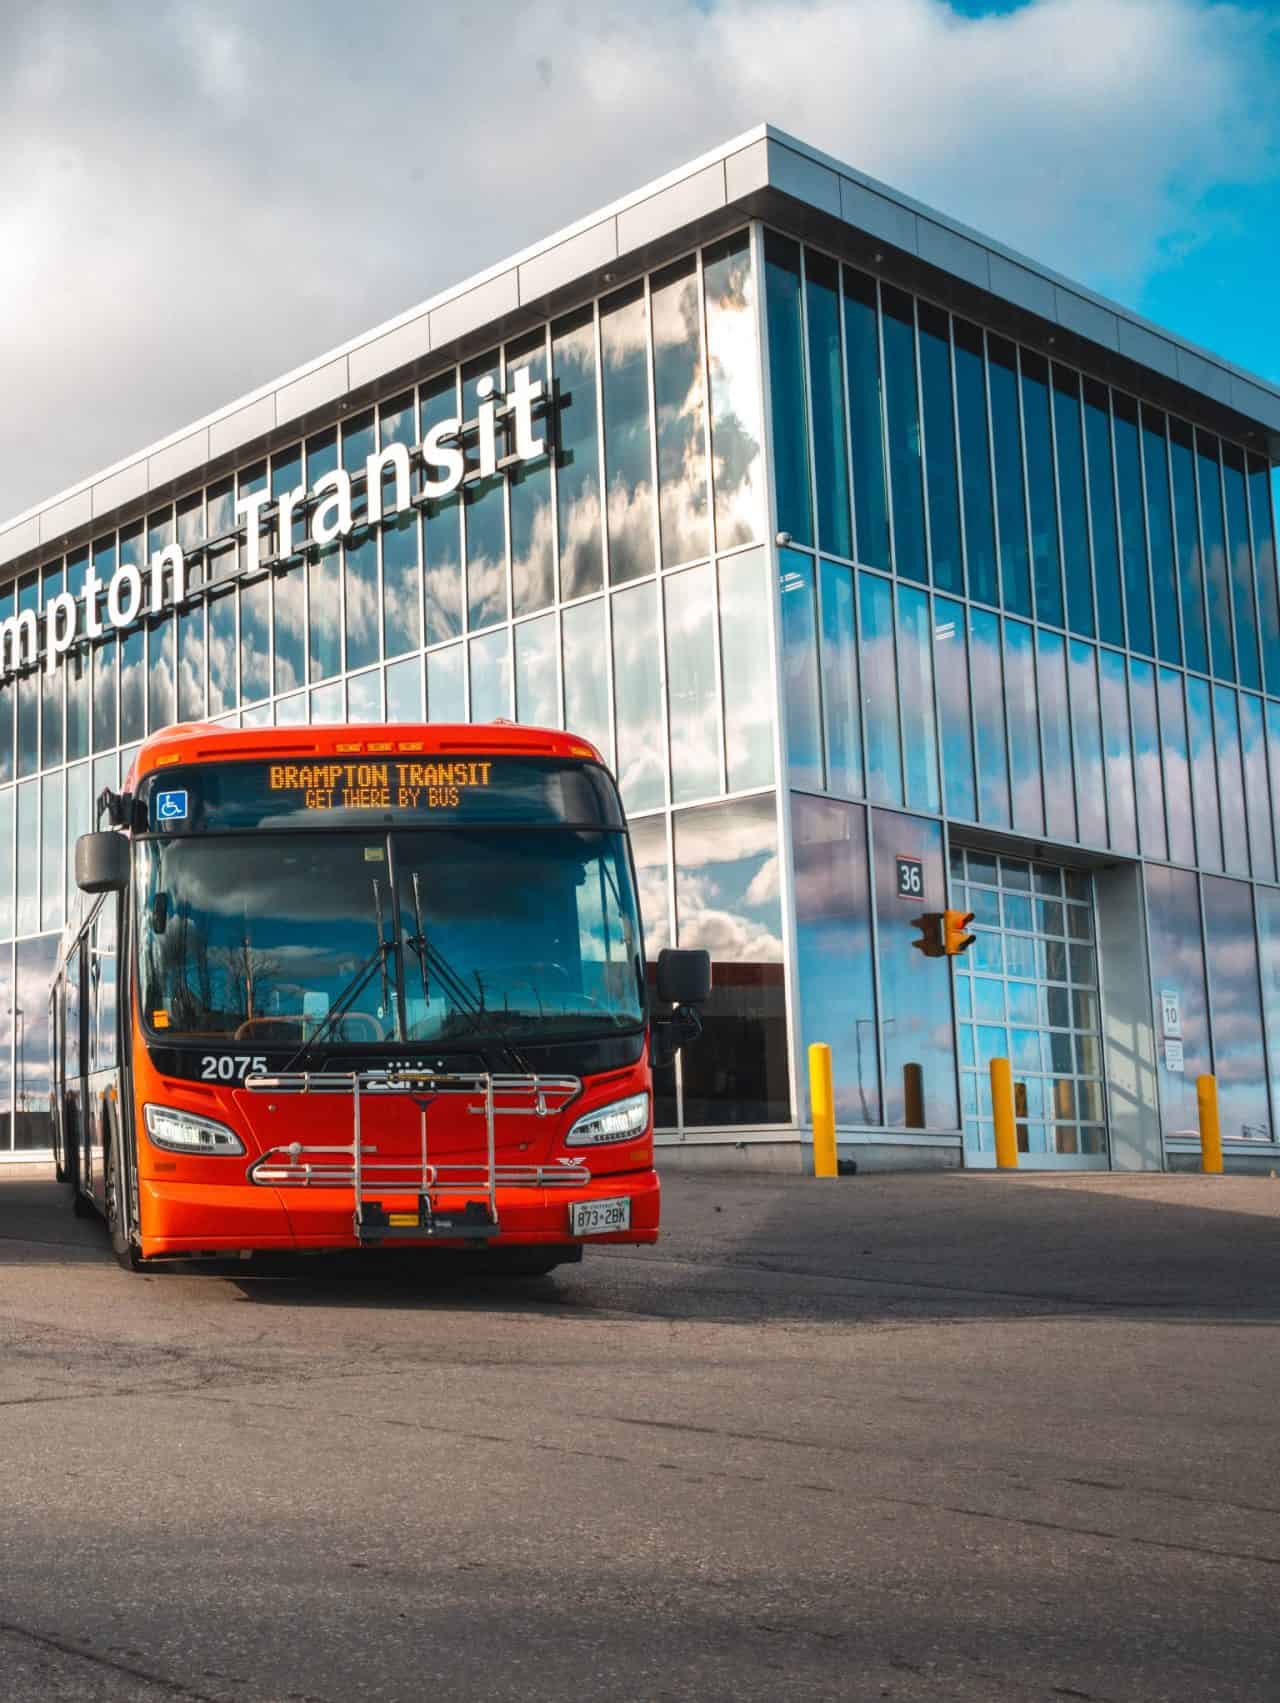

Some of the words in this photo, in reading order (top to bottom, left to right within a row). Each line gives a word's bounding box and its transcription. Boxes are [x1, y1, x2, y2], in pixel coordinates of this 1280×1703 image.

[233, 367, 548, 573] Transit
[270, 765, 388, 788] BRAMPTON
[396, 763, 492, 785] TRANSIT
[306, 790, 334, 809] GET
[342, 788, 392, 808] THERE
[399, 788, 420, 807] BY
[429, 787, 460, 807] BUS
[901, 865, 920, 892] 36
[1166, 1008, 1177, 1023] 10
[201, 1057, 268, 1079] 2075
